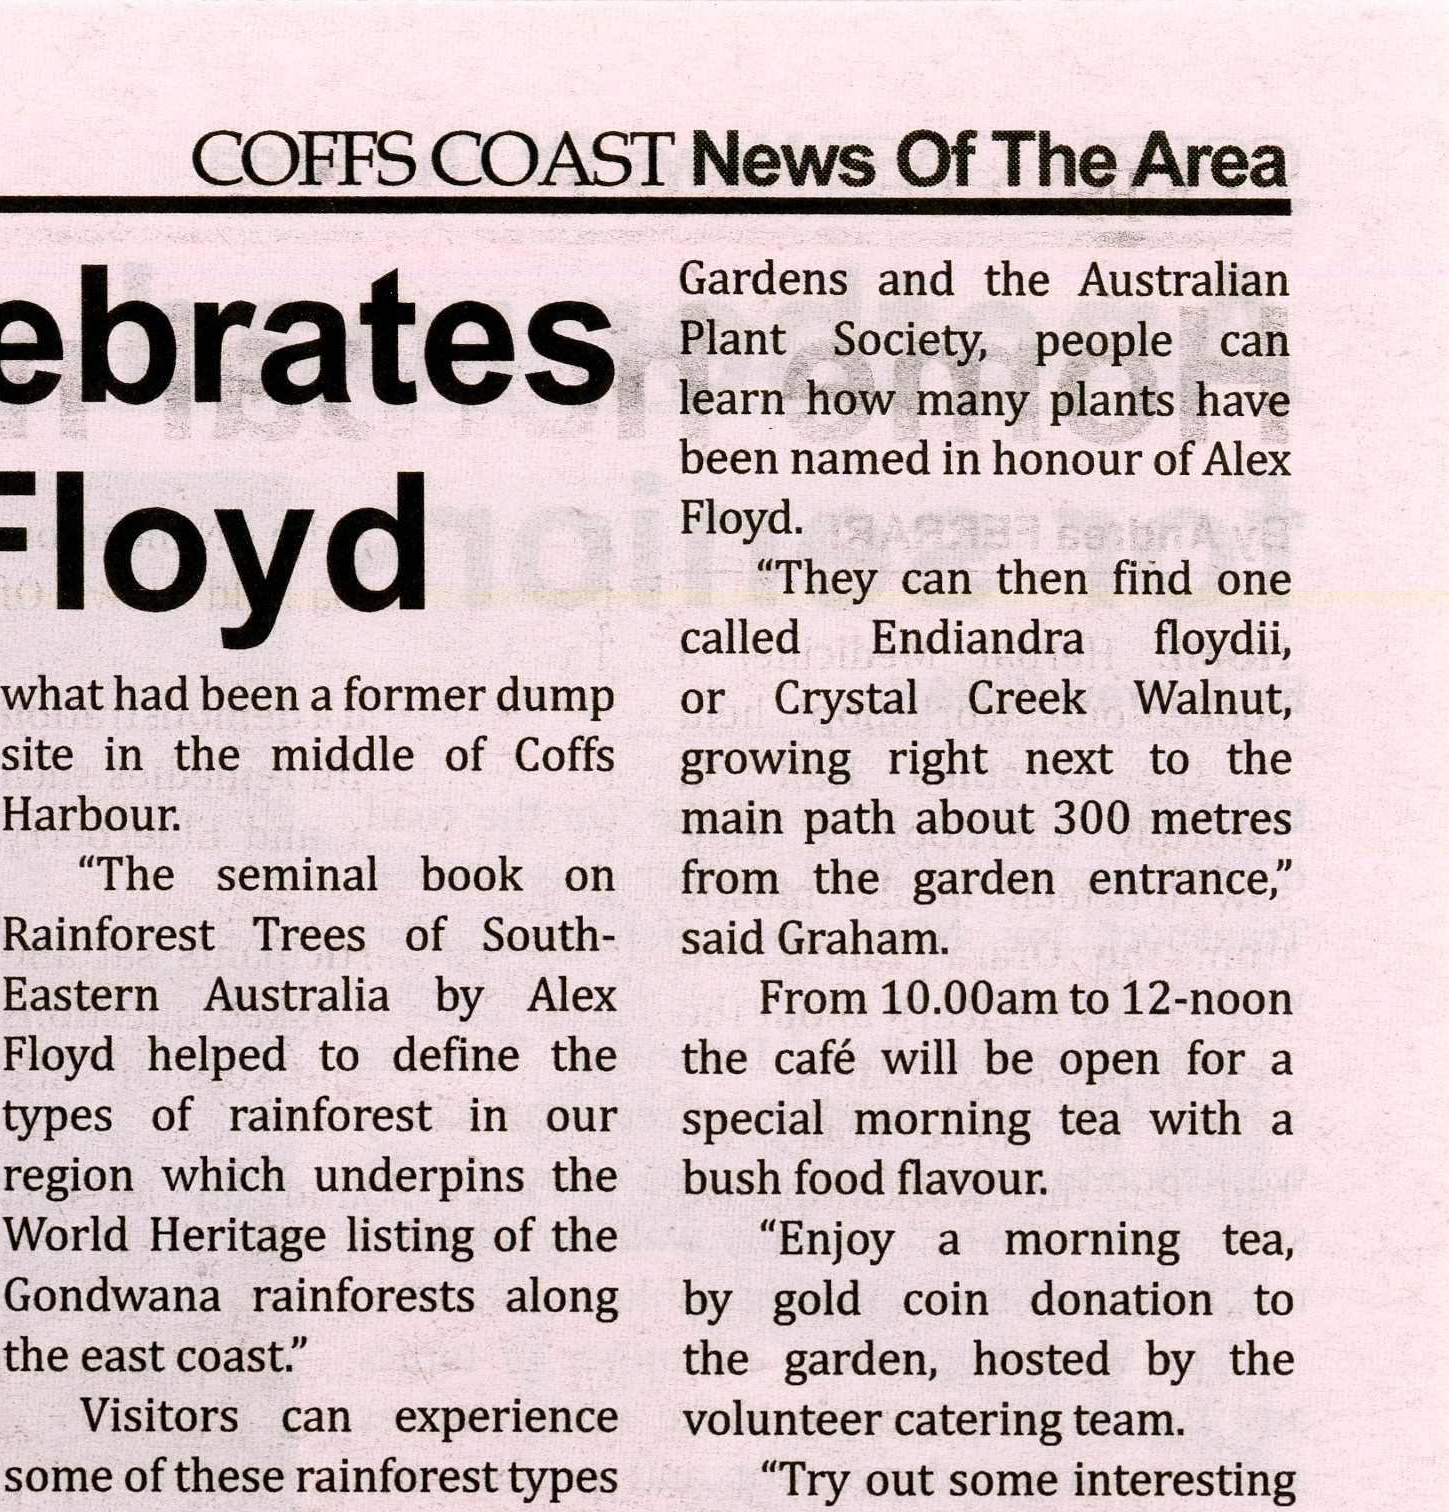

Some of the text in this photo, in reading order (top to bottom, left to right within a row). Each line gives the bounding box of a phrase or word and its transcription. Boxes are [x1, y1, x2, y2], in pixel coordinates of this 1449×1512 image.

[192, 129, 1287, 189] COFFS COAST News Of The Area
[680, 318, 1290, 368] Plant Society, people can
[680, 618, 1291, 666] called Endiandra floydii,
[3, 914, 615, 952] Rainforest Trees of South-
[760, 979, 1292, 1015] From 10.00am to 12-noon
[2, 1215, 618, 1263] World Heritage listing of the
[683, 1339, 1295, 1386] the garden, hosted by the
